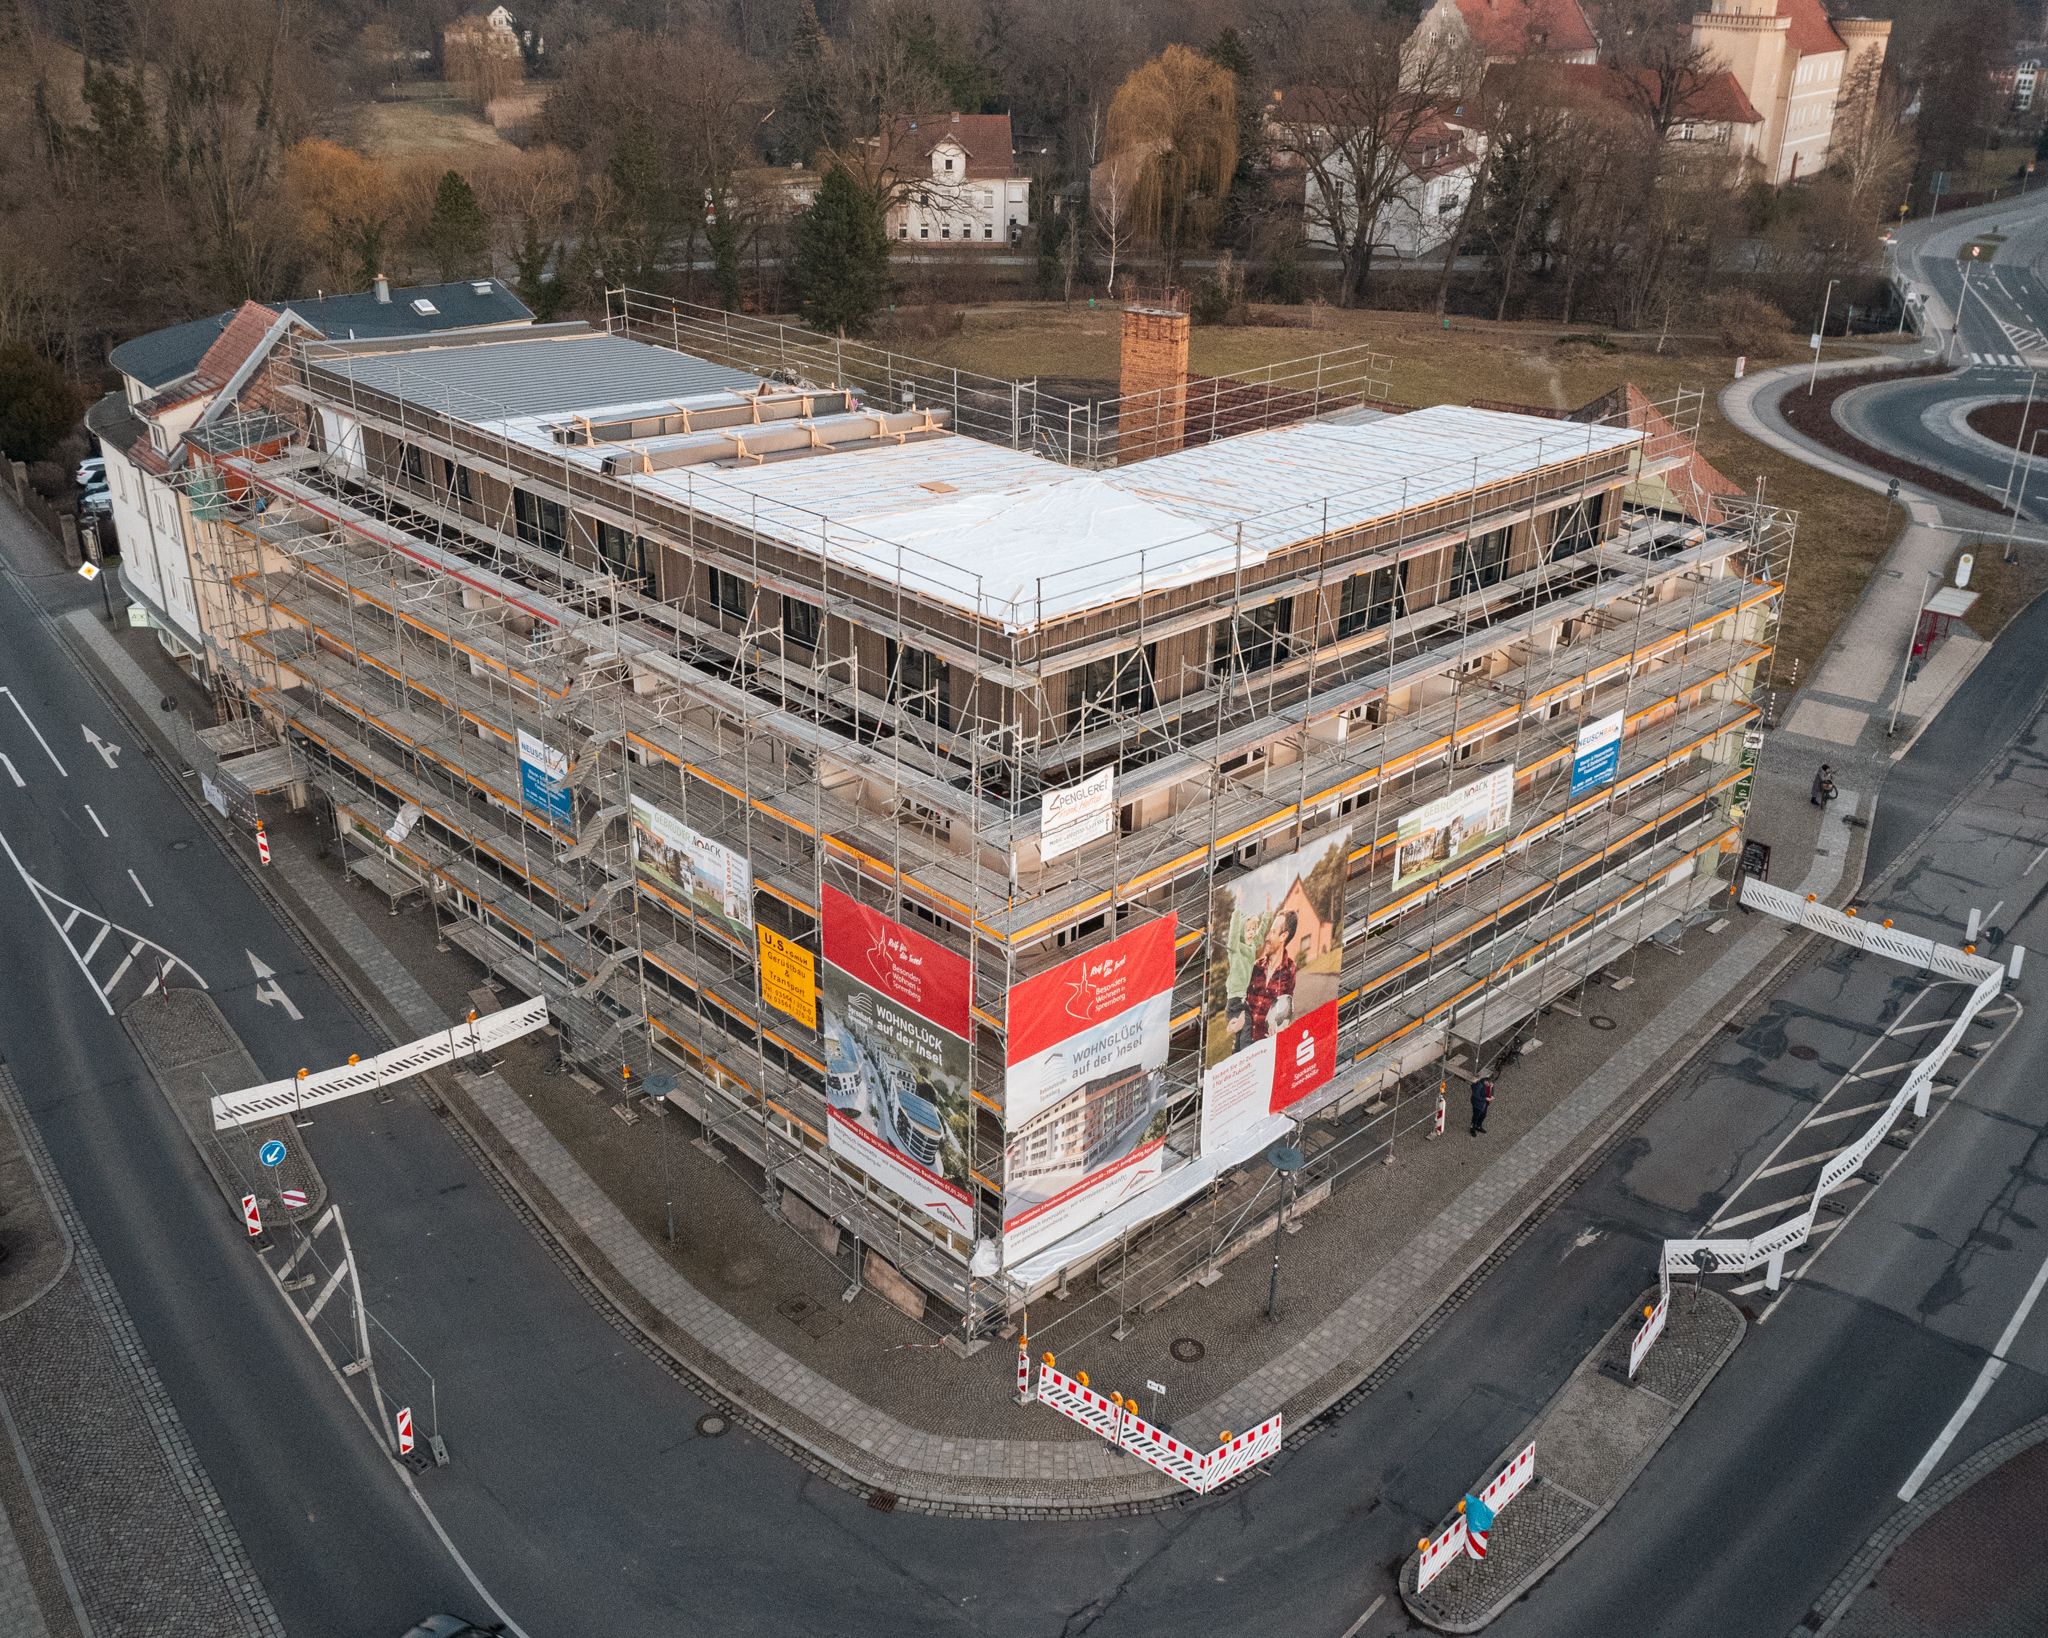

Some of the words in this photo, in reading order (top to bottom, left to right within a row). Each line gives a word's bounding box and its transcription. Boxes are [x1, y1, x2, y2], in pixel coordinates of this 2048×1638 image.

[1464, 780, 1488, 800] NOACK
[654, 812, 691, 840] GEBRÜDER
[692, 835, 721, 858] NOACK
[767, 951, 806, 978] Gerüstbau
[784, 969, 790, 978] &
[892, 962, 922, 985] Besonders
[769, 971, 805, 997] Transport
[892, 971, 916, 990] Wohnen
[892, 980, 922, 1003] Spremberg
[1095, 976, 1127, 995] Besonders
[1095, 993, 1126, 1012] Spremberg
[1096, 987, 1121, 1004] Wohnen
[876, 1004, 943, 1053] WOHNGLÜCK
[877, 1020, 893, 1037] auf
[896, 1030, 914, 1048] der
[917, 1041, 943, 1066] Insel
[1072, 1020, 1144, 1065] WOHNGLÜCK
[1072, 1062, 1091, 1079] auf
[1093, 1051, 1113, 1069] der
[1117, 1035, 1143, 1059] Insel
[1293, 1063, 1317, 1081] Sparkasse
